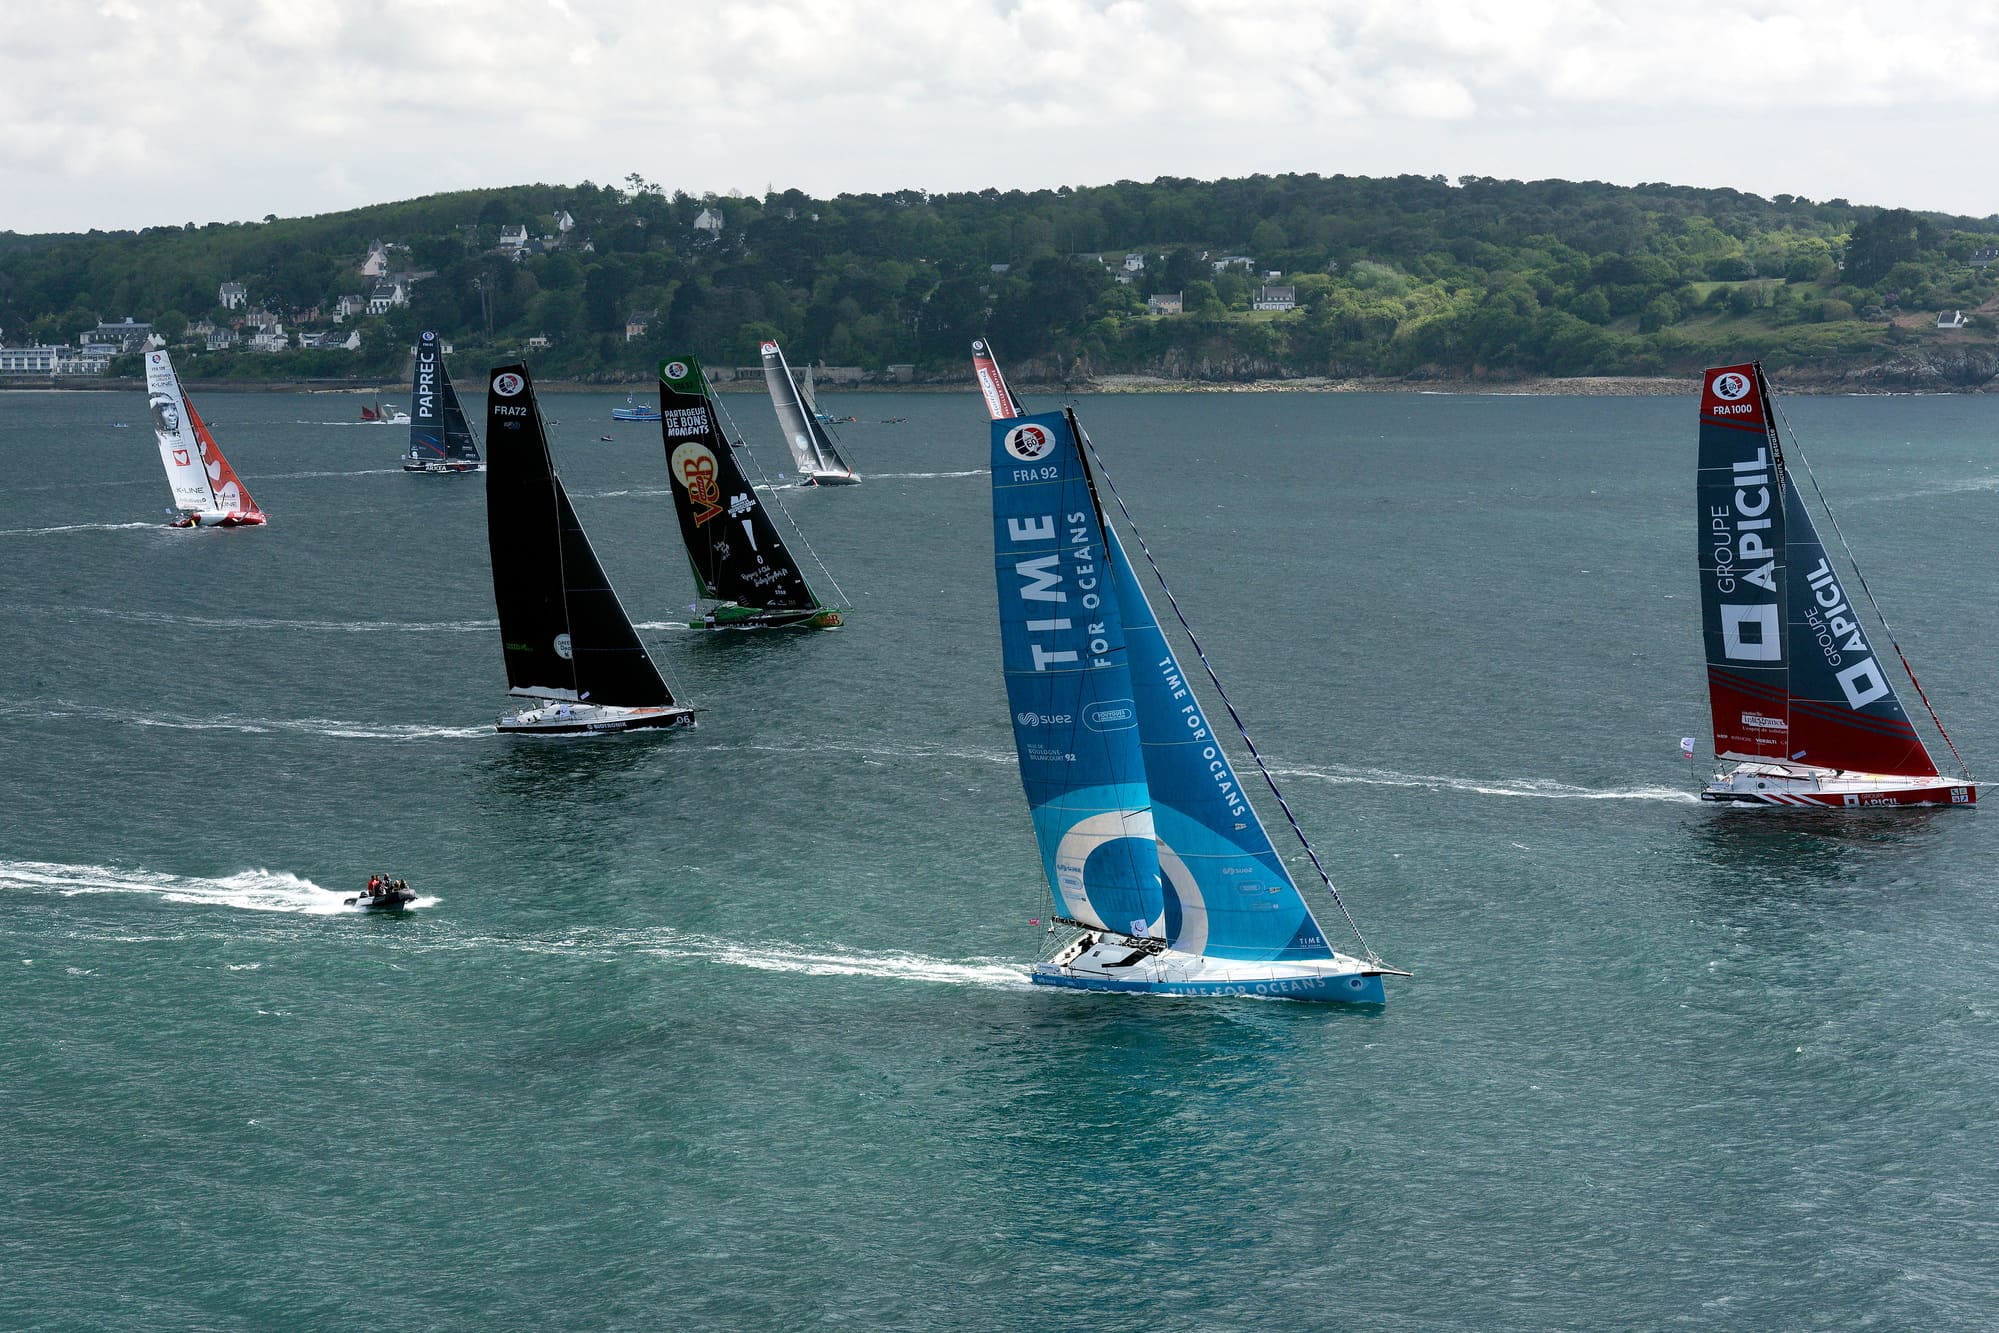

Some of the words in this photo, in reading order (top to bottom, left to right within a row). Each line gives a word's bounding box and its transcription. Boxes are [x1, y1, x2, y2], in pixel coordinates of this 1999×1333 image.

[419, 353, 434, 418] PAPREC
[494, 405, 527, 416] FRA72
[664, 407, 705, 418] PARTAGEUR
[666, 417, 679, 428] DE
[680, 415, 708, 427] BONS
[668, 425, 709, 437] MOMENTS
[1733, 447, 1777, 593] APICIL
[1067, 511, 1100, 610] OCEANS
[1711, 505, 1736, 594] GROUPE
[1007, 515, 1079, 671] TIME
[1806, 558, 1868, 651] APICIL
[1088, 621, 1112, 668] FOR
[1804, 606, 1842, 667] GROUPE
[1039, 714, 1073, 724] suez
[1158, 656, 1187, 700] TIME
[1181, 704, 1206, 742] FOR
[1202, 746, 1245, 817] OCEANS
[1064, 753, 1077, 761] 92
[1299, 936, 1321, 945] TIME
[1255, 978, 1327, 994] OCEANS
